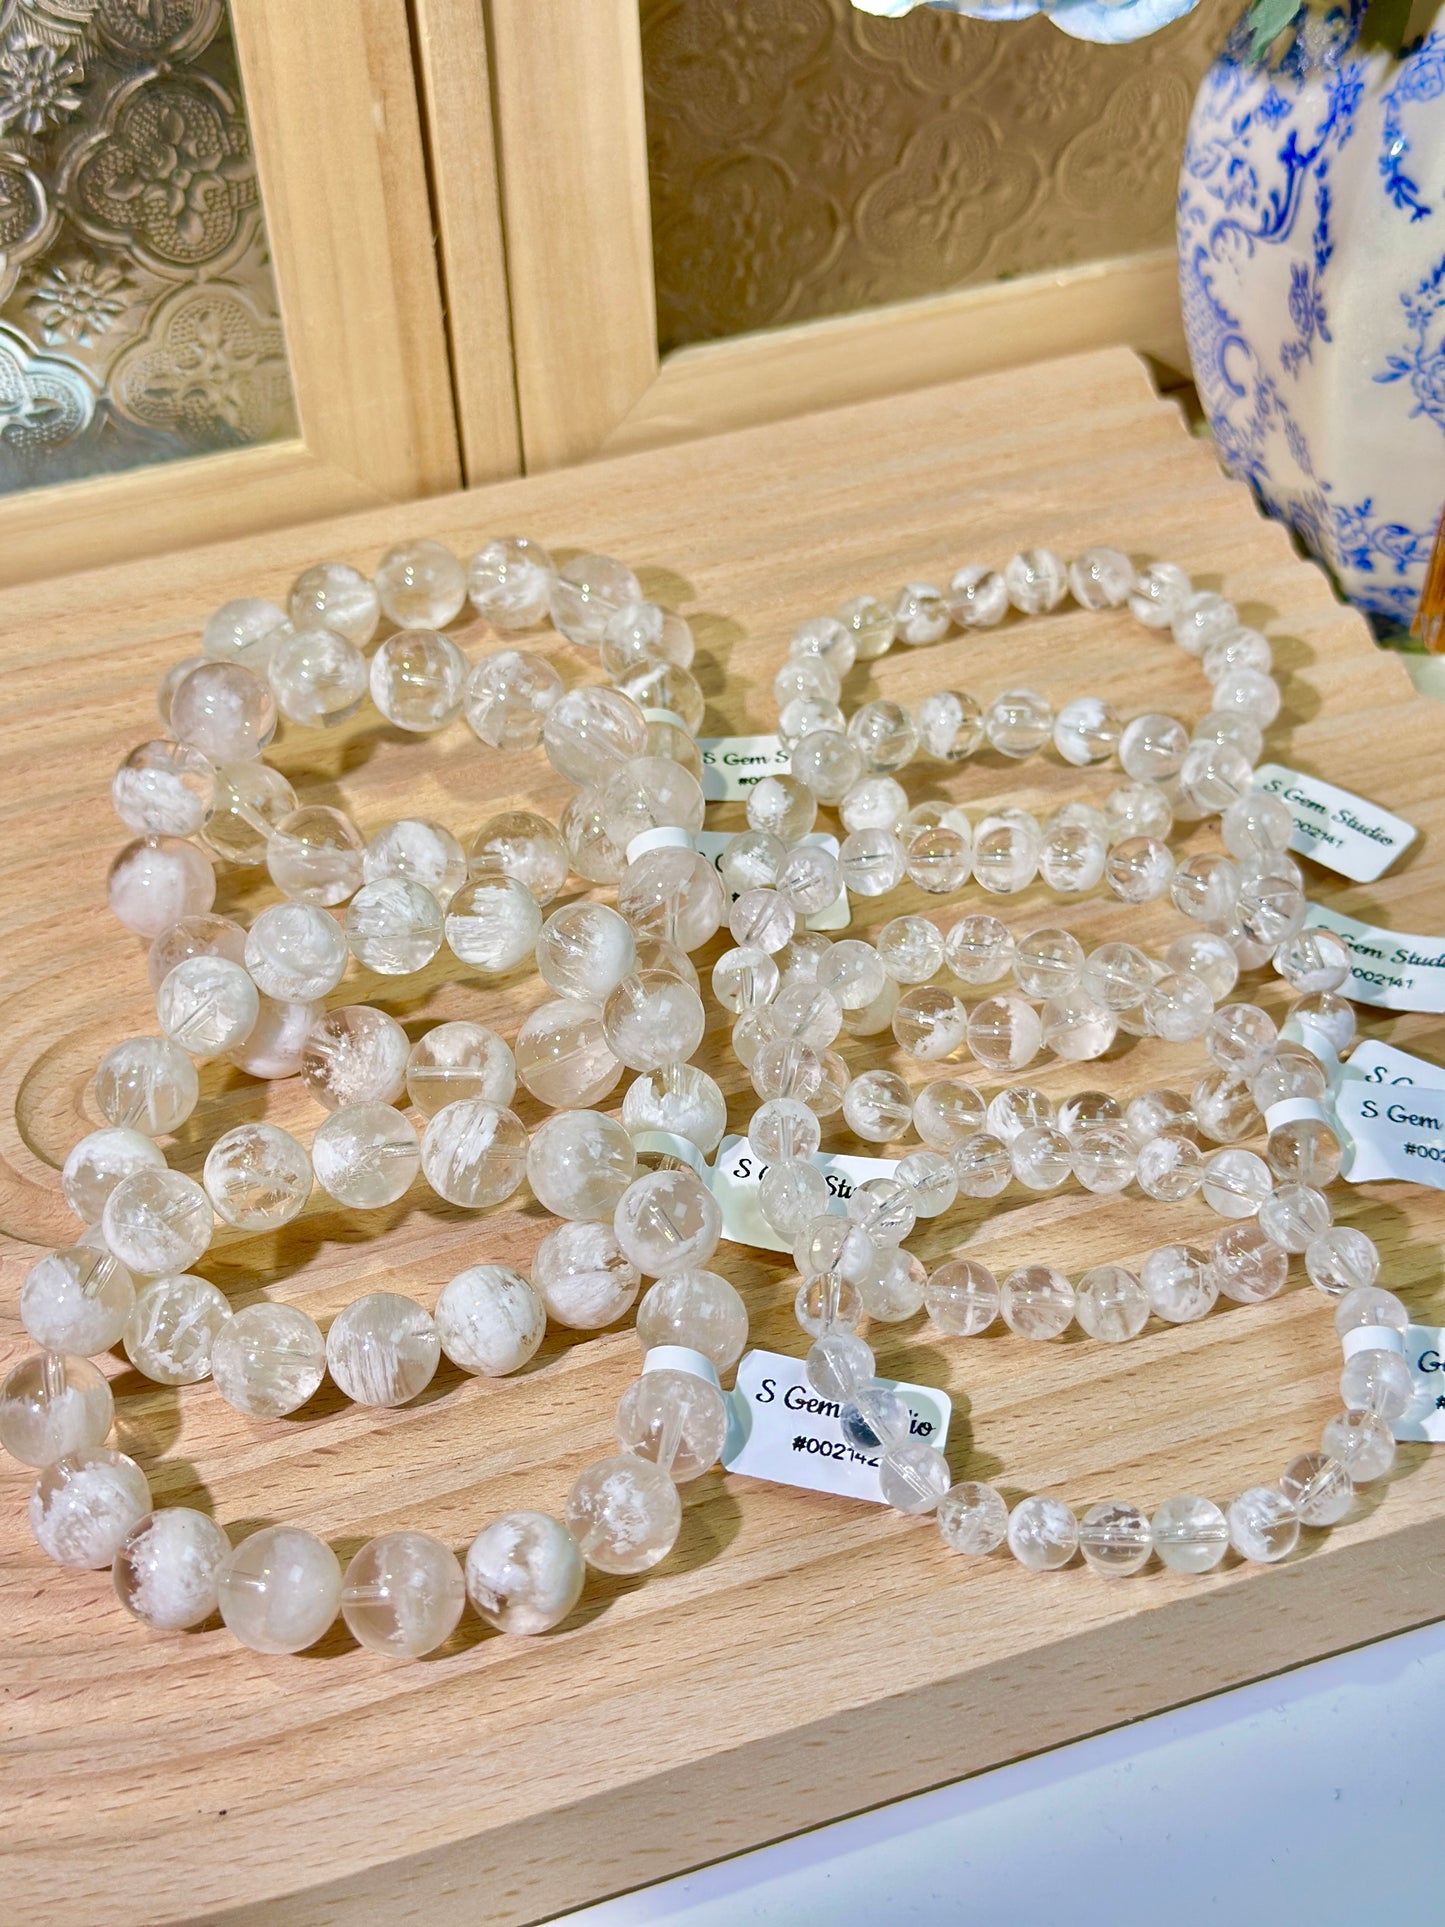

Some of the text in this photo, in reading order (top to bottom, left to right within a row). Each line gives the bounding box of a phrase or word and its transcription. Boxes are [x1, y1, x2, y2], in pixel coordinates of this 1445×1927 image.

[703, 751, 717, 765] S
[723, 752, 769, 766] Gem
[1263, 779, 1394, 847] S Gem Studio
[1390, 948, 1445, 968] Stud
[1351, 965, 1415, 990] 002141
[1364, 1065, 1388, 1084] S
[1360, 1099, 1443, 1131] S Gem
[732, 1157, 752, 1179] S
[825, 1174, 858, 1200] Stu
[755, 1378, 841, 1419] S Gem
